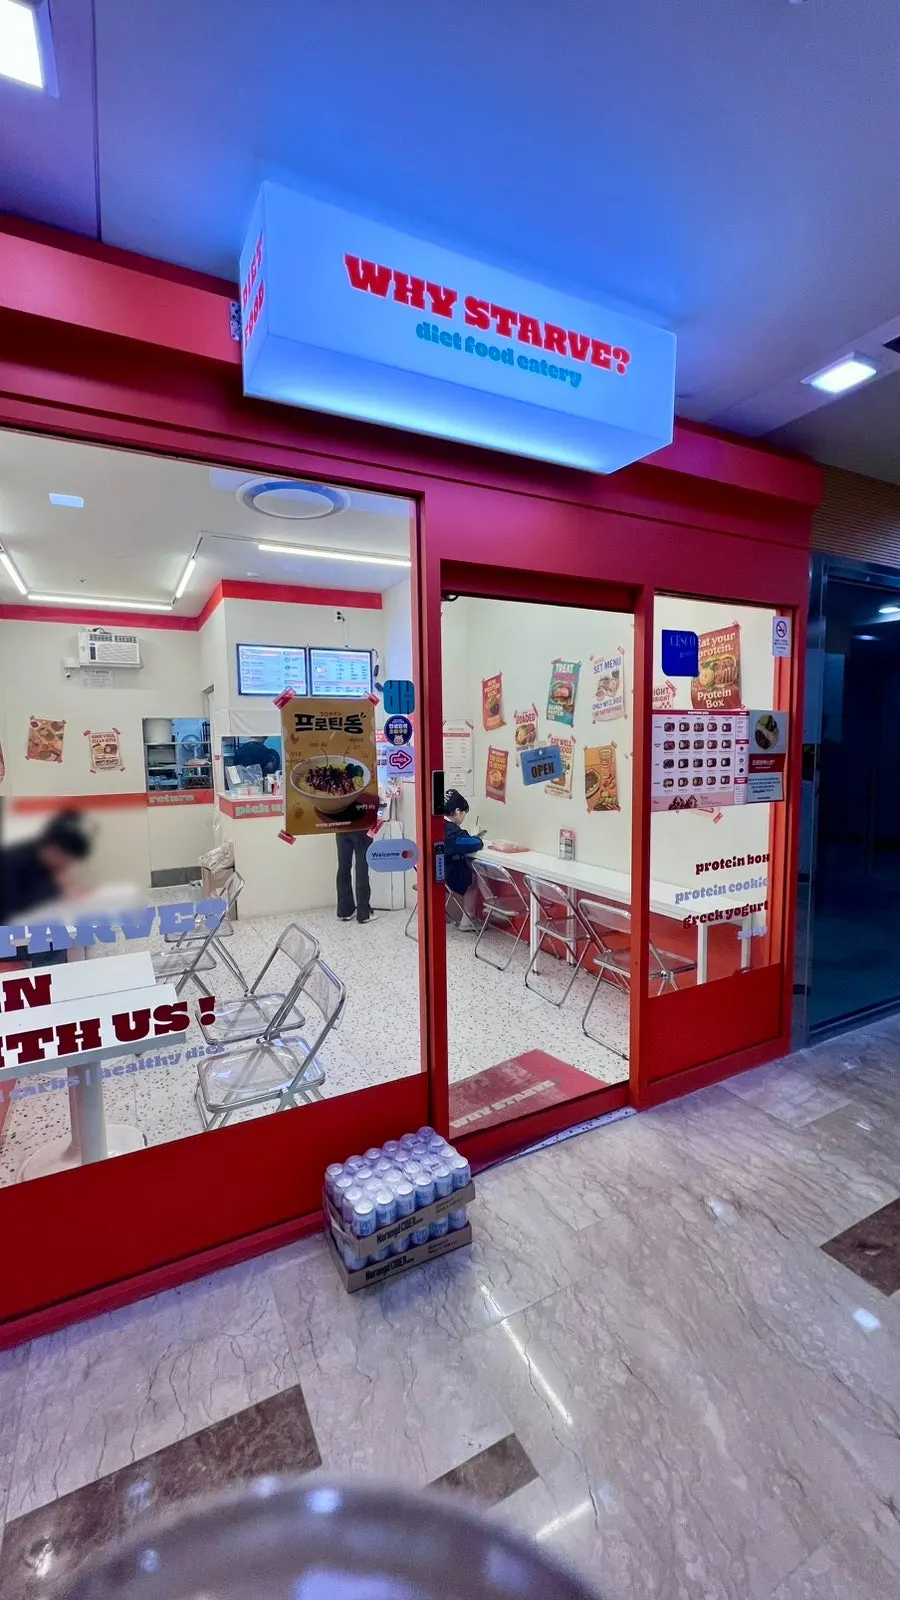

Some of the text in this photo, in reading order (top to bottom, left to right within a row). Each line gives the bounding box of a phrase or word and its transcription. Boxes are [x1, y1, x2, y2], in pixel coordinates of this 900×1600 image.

[242, 230, 263, 312] DIET
[244, 280, 265, 351] FOOD
[344, 252, 632, 376] WHY STARVE?
[415, 322, 583, 389] diet food eatery
[711, 632, 736, 647] your
[604, 656, 621, 670] MENU
[697, 688, 732, 701] Protein
[706, 699, 725, 709] Box
[294, 713, 364, 735] 프로틴동
[531, 762, 555, 779] OPEN
[695, 853, 771, 876] protein box
[674, 884, 727, 905] protein
[681, 900, 769, 930] greek yogurt
[0, 1017, 103, 1069] TH
[98, 1051, 182, 1080] healthy
